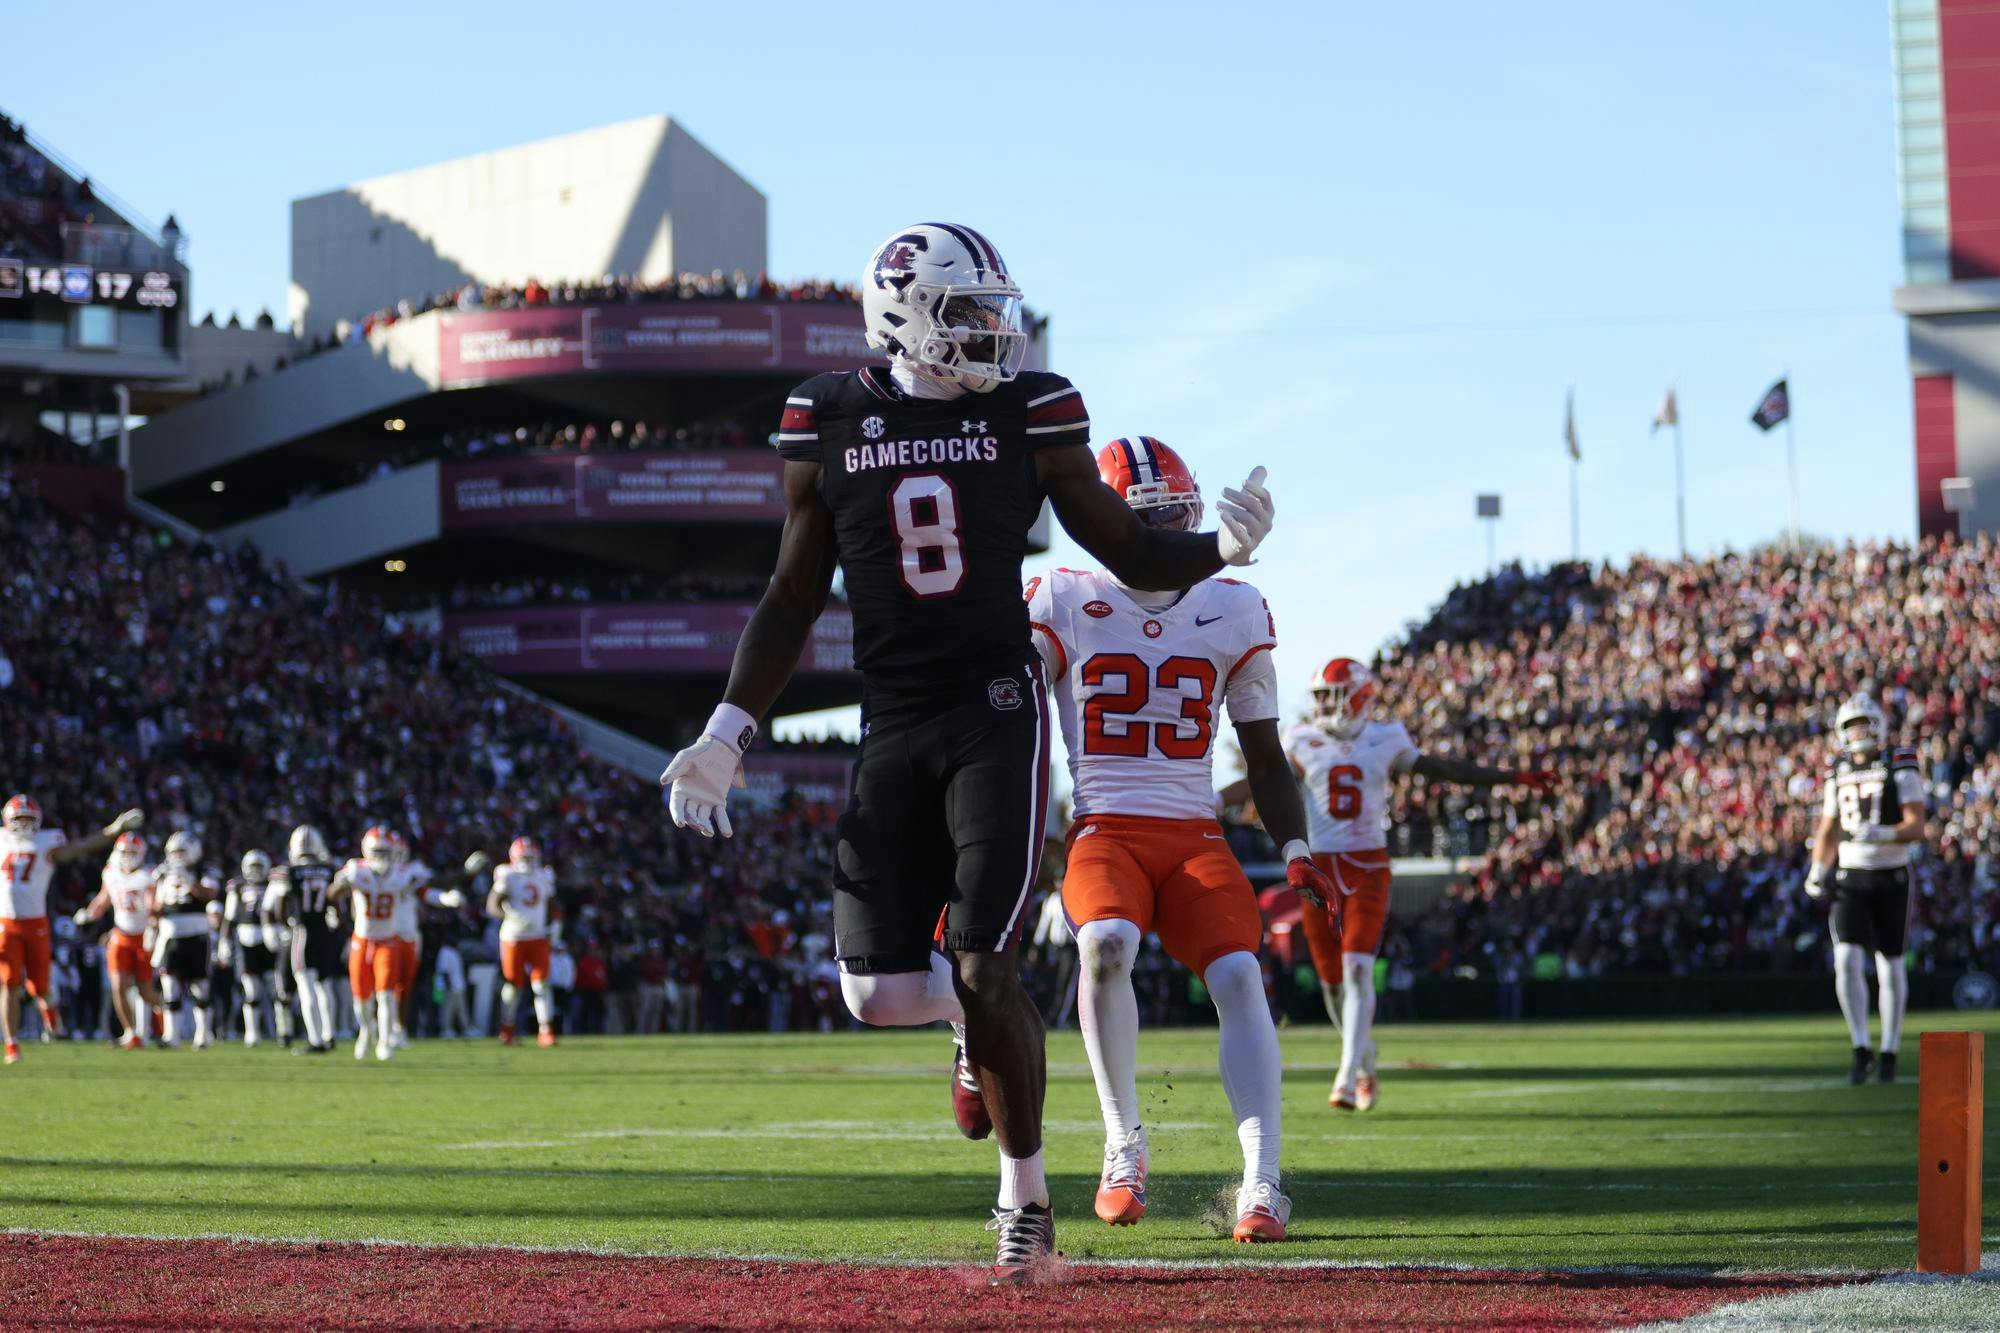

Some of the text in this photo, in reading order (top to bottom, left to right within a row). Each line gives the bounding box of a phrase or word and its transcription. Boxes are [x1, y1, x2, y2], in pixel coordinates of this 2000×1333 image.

[26, 267, 62, 294] 14
[97, 271, 132, 298] 17
[861, 416, 885, 439] SEC
[844, 436, 998, 473] GAMECOCKS
[890, 472, 966, 597] 8
[1084, 602, 1109, 613] ACC
[1081, 652, 1218, 760] 23
[1328, 764, 1364, 821] 6
[1837, 780, 1885, 832] 87
[0, 851, 37, 881] 47
[302, 878, 328, 913] 17
[521, 883, 541, 906] 3
